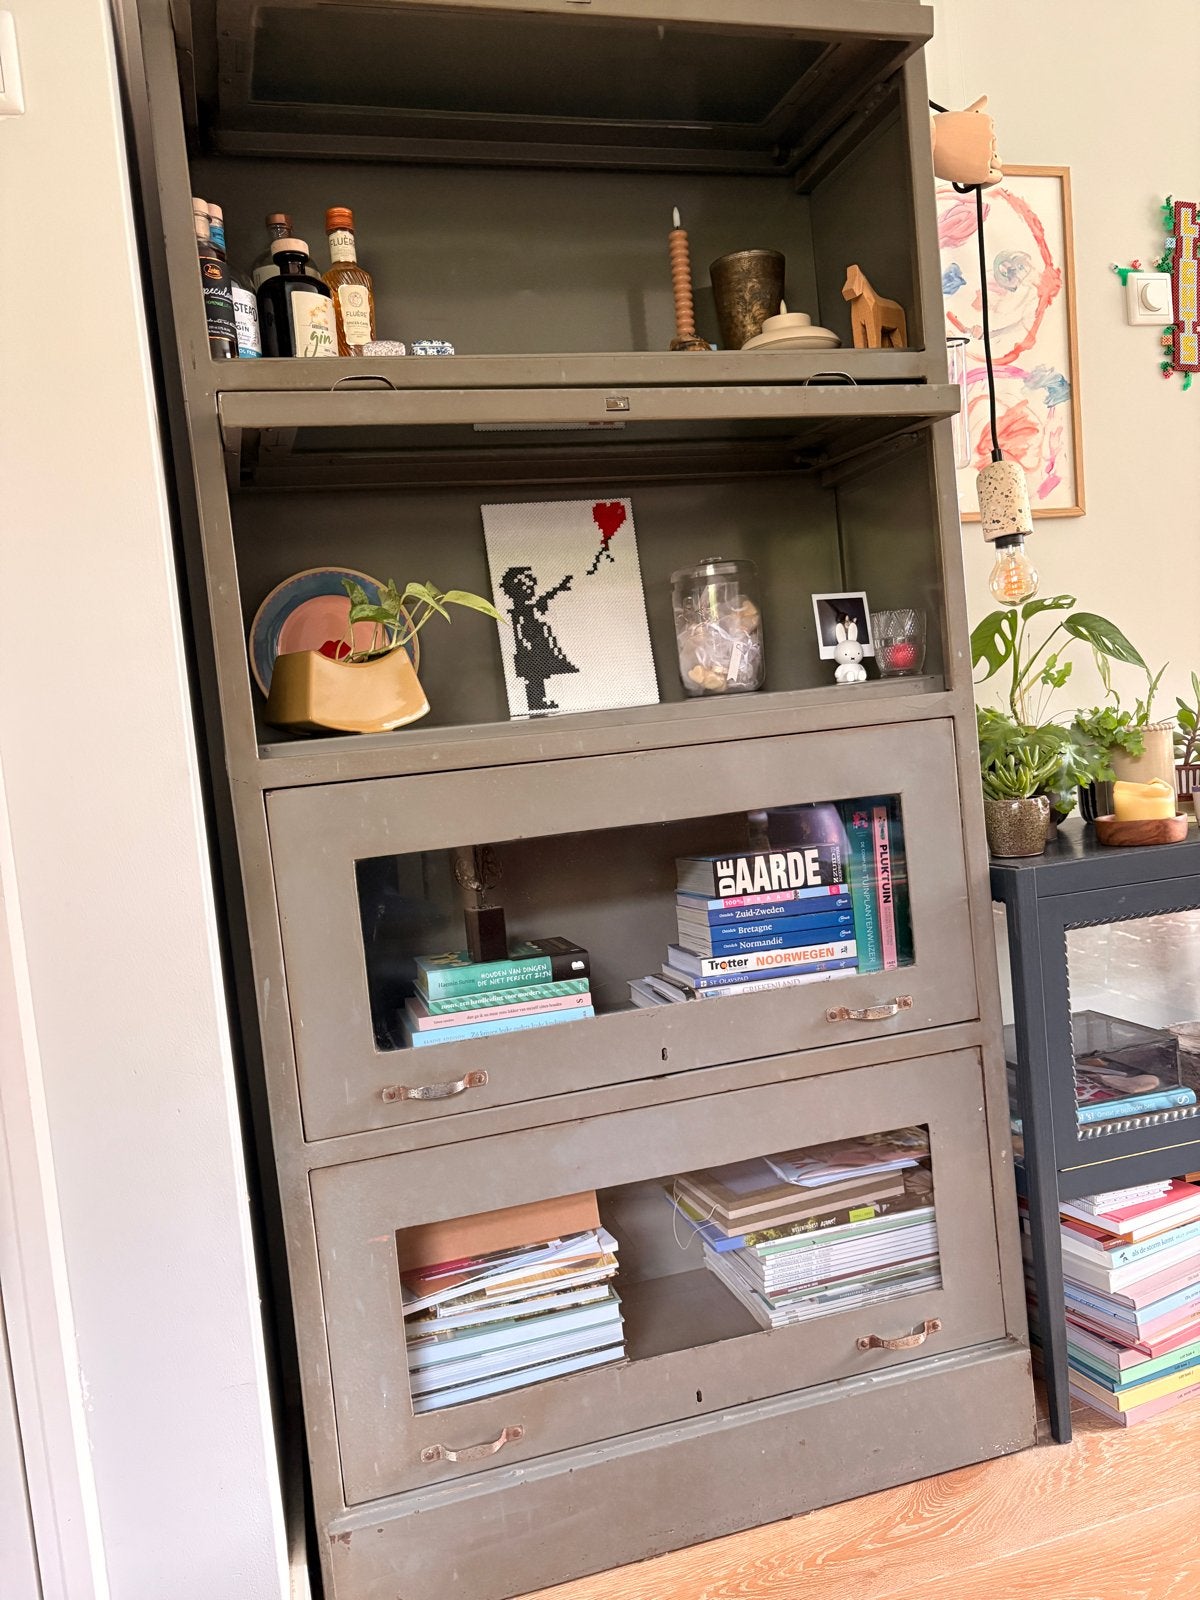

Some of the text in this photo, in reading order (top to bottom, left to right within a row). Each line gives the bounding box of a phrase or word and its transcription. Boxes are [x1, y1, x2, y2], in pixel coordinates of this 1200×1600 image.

[305, 331, 332, 357] gin
[716, 859, 736, 897] DE
[735, 848, 822, 895] AARDE
[879, 844, 892, 904] PLUKTUIN
[735, 905, 785, 919] Zuid-Zweden
[861, 875, 877, 964] TUINPLANTENWIJZER
[738, 924, 773, 935] Bretagne
[739, 937, 783, 949] Normandië
[708, 947, 835, 971] Trotter NOORWEGEN
[477, 970, 552, 988] DIE NIET PERFECT ZIJN
[481, 963, 547, 980] HOUDEN VAN DINGEN
[719, 975, 749, 984] OLAVSPAD
[1146, 1241, 1161, 1252] storm
[1161, 1236, 1174, 1245] komt
